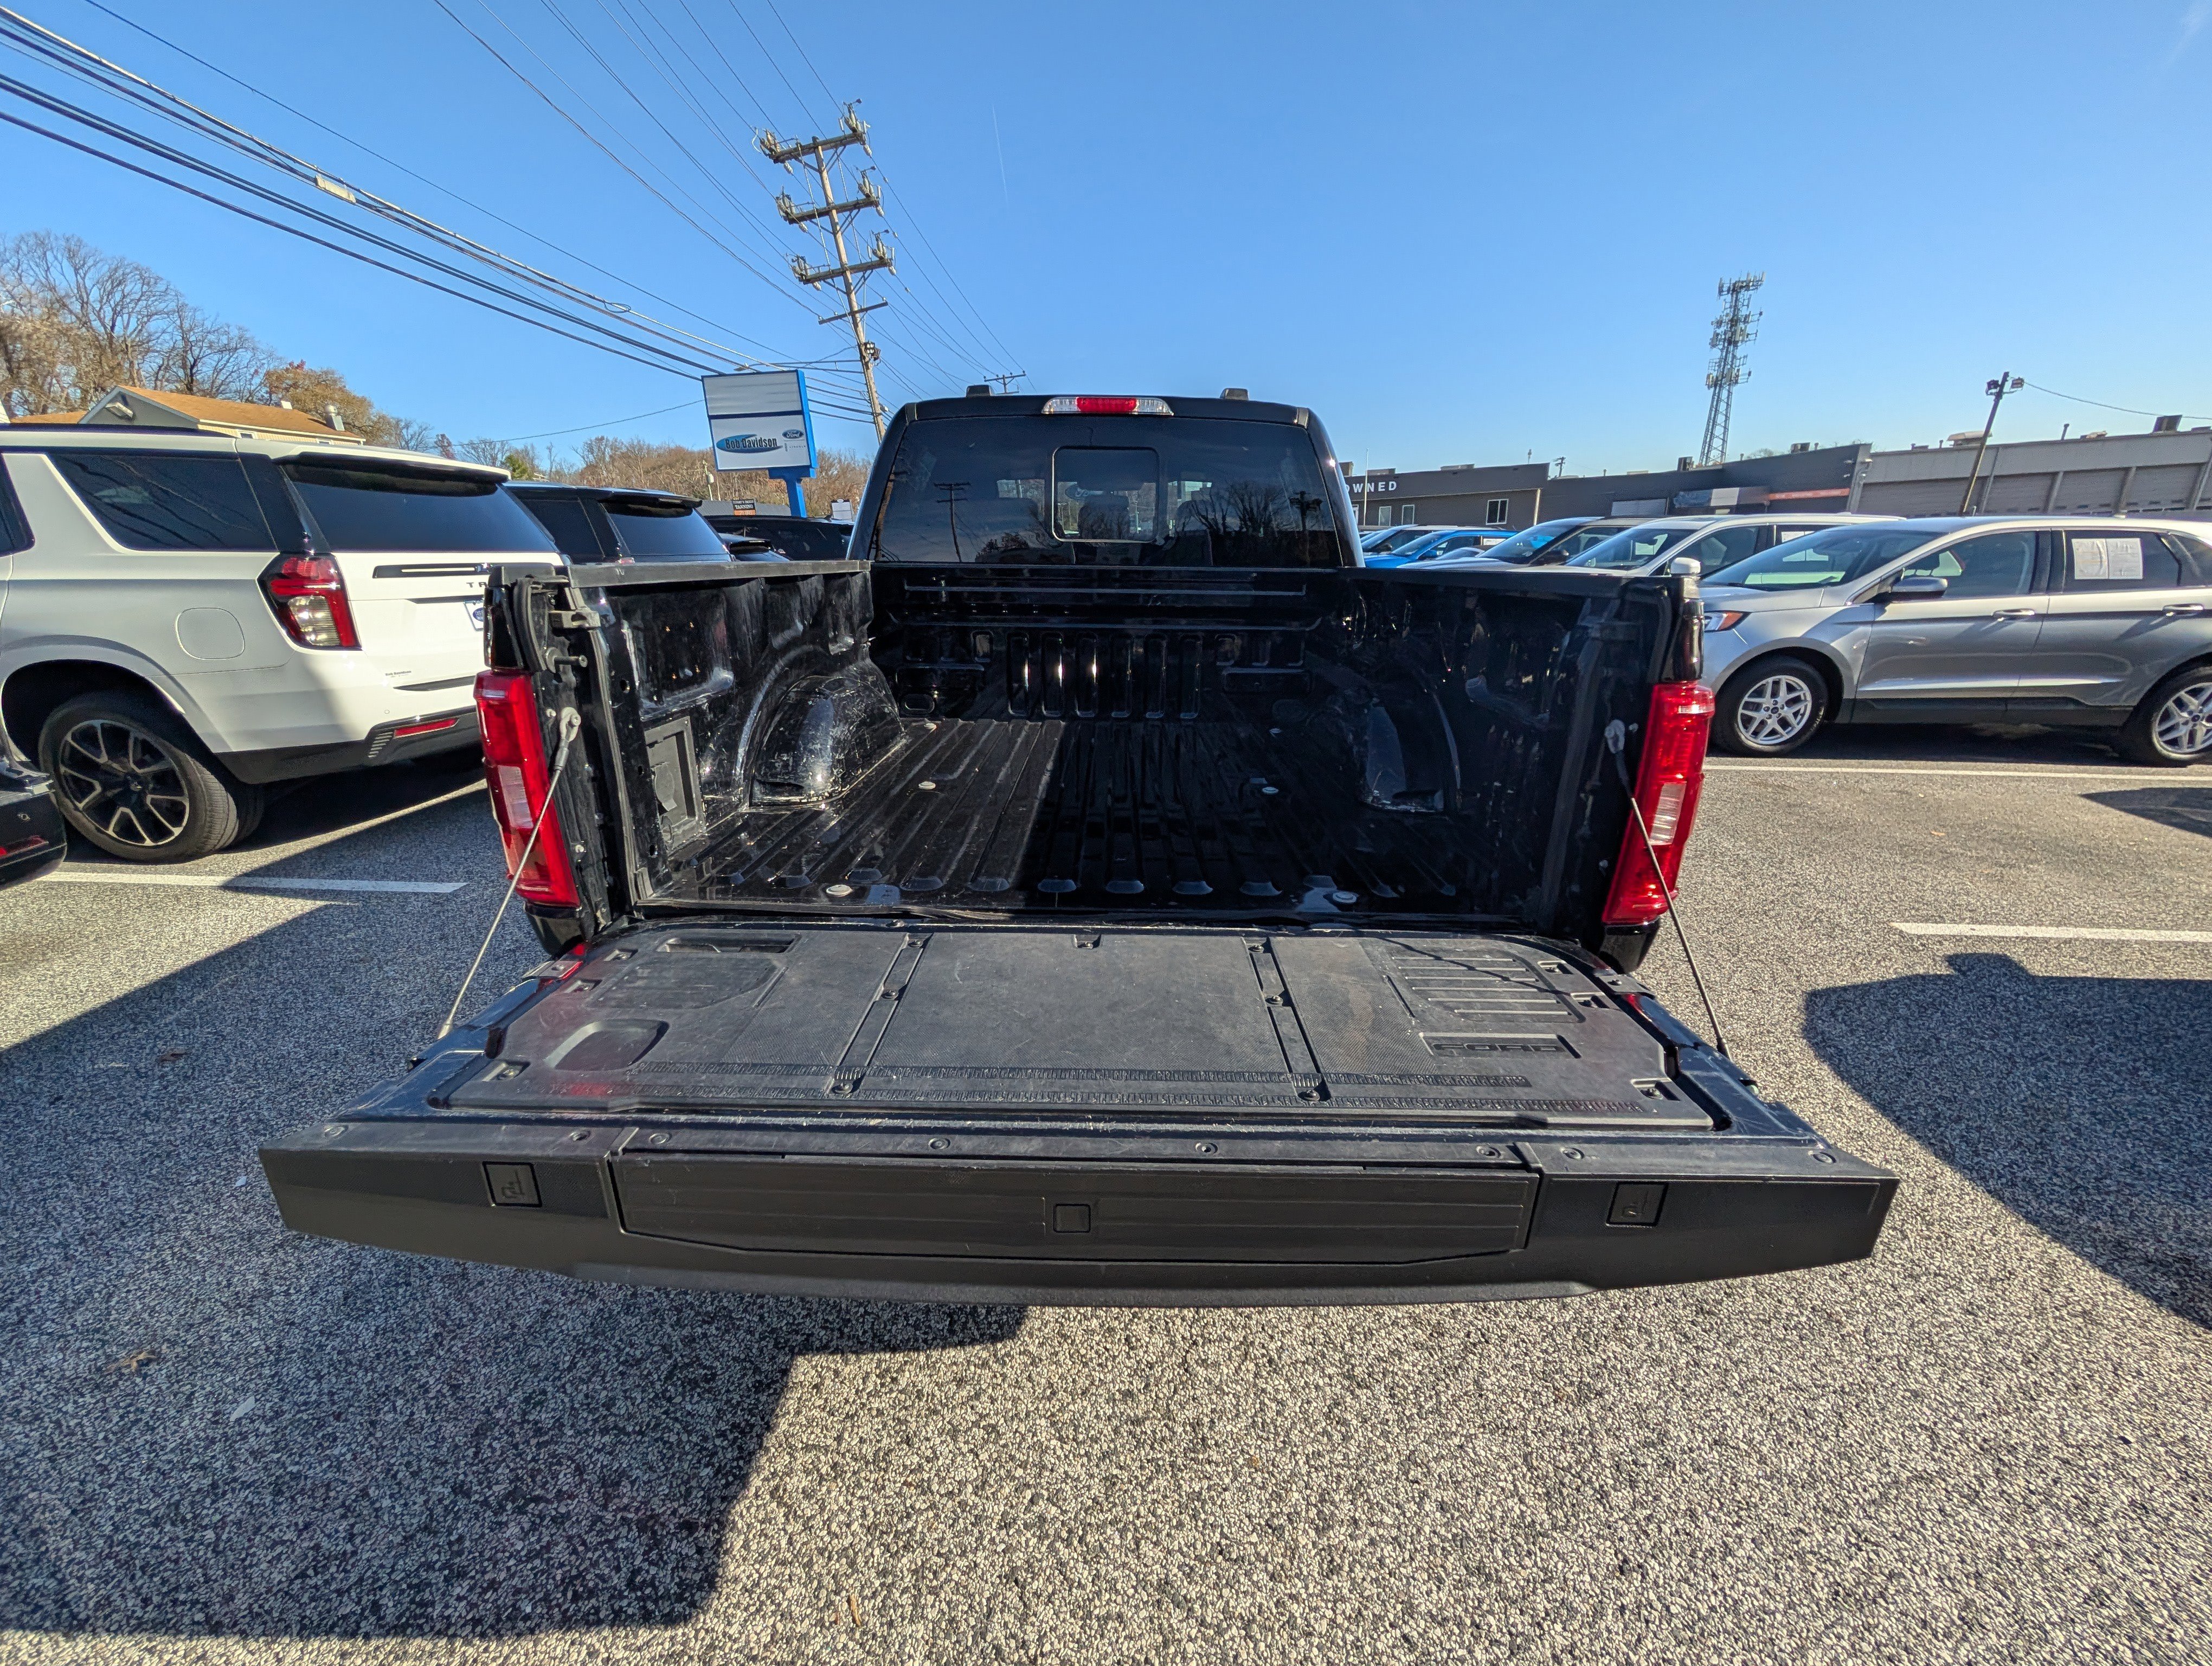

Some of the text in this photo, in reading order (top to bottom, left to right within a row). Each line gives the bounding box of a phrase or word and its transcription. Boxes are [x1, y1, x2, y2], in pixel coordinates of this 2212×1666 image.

[725, 439, 740, 449] Bob
[741, 437, 777, 448] Davidson
[1431, 1043, 1566, 1052] FORD
